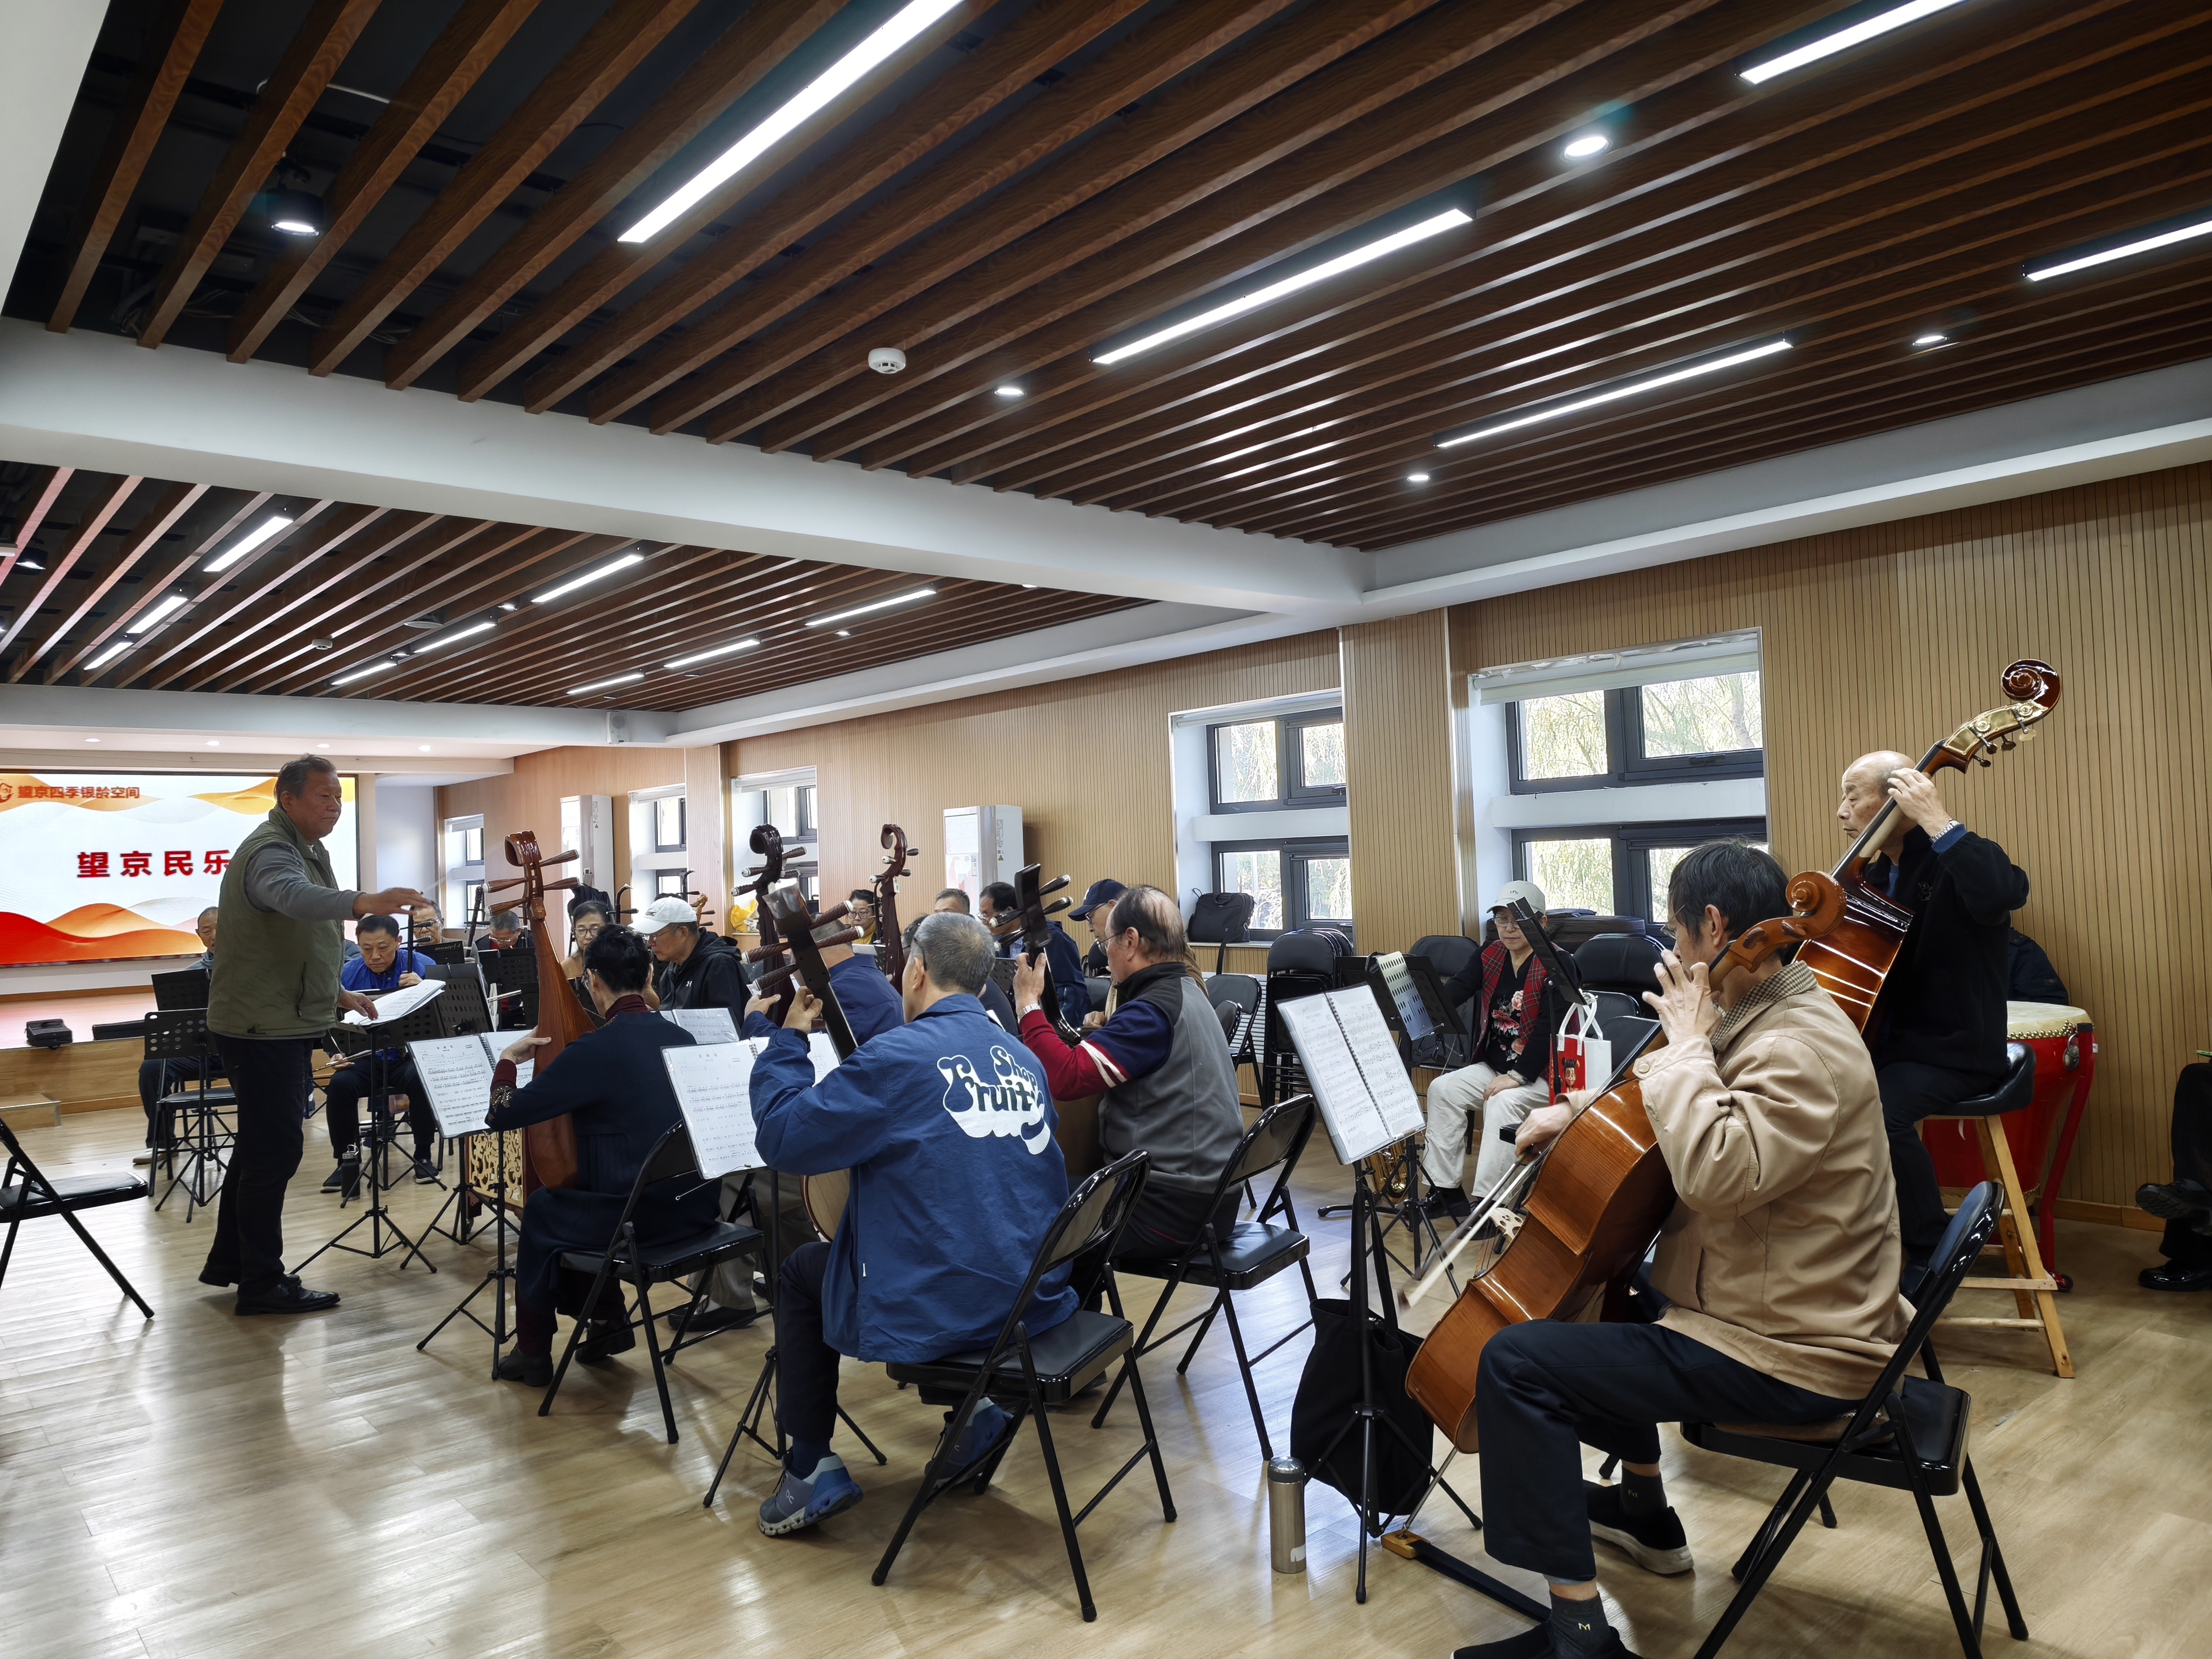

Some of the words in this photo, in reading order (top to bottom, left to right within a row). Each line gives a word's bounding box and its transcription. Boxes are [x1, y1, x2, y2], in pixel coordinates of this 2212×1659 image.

[18, 786, 140, 799] 望京四季银龄空间
[77, 849, 231, 878] 望京民乐
[990, 1046, 1038, 1091] Shop
